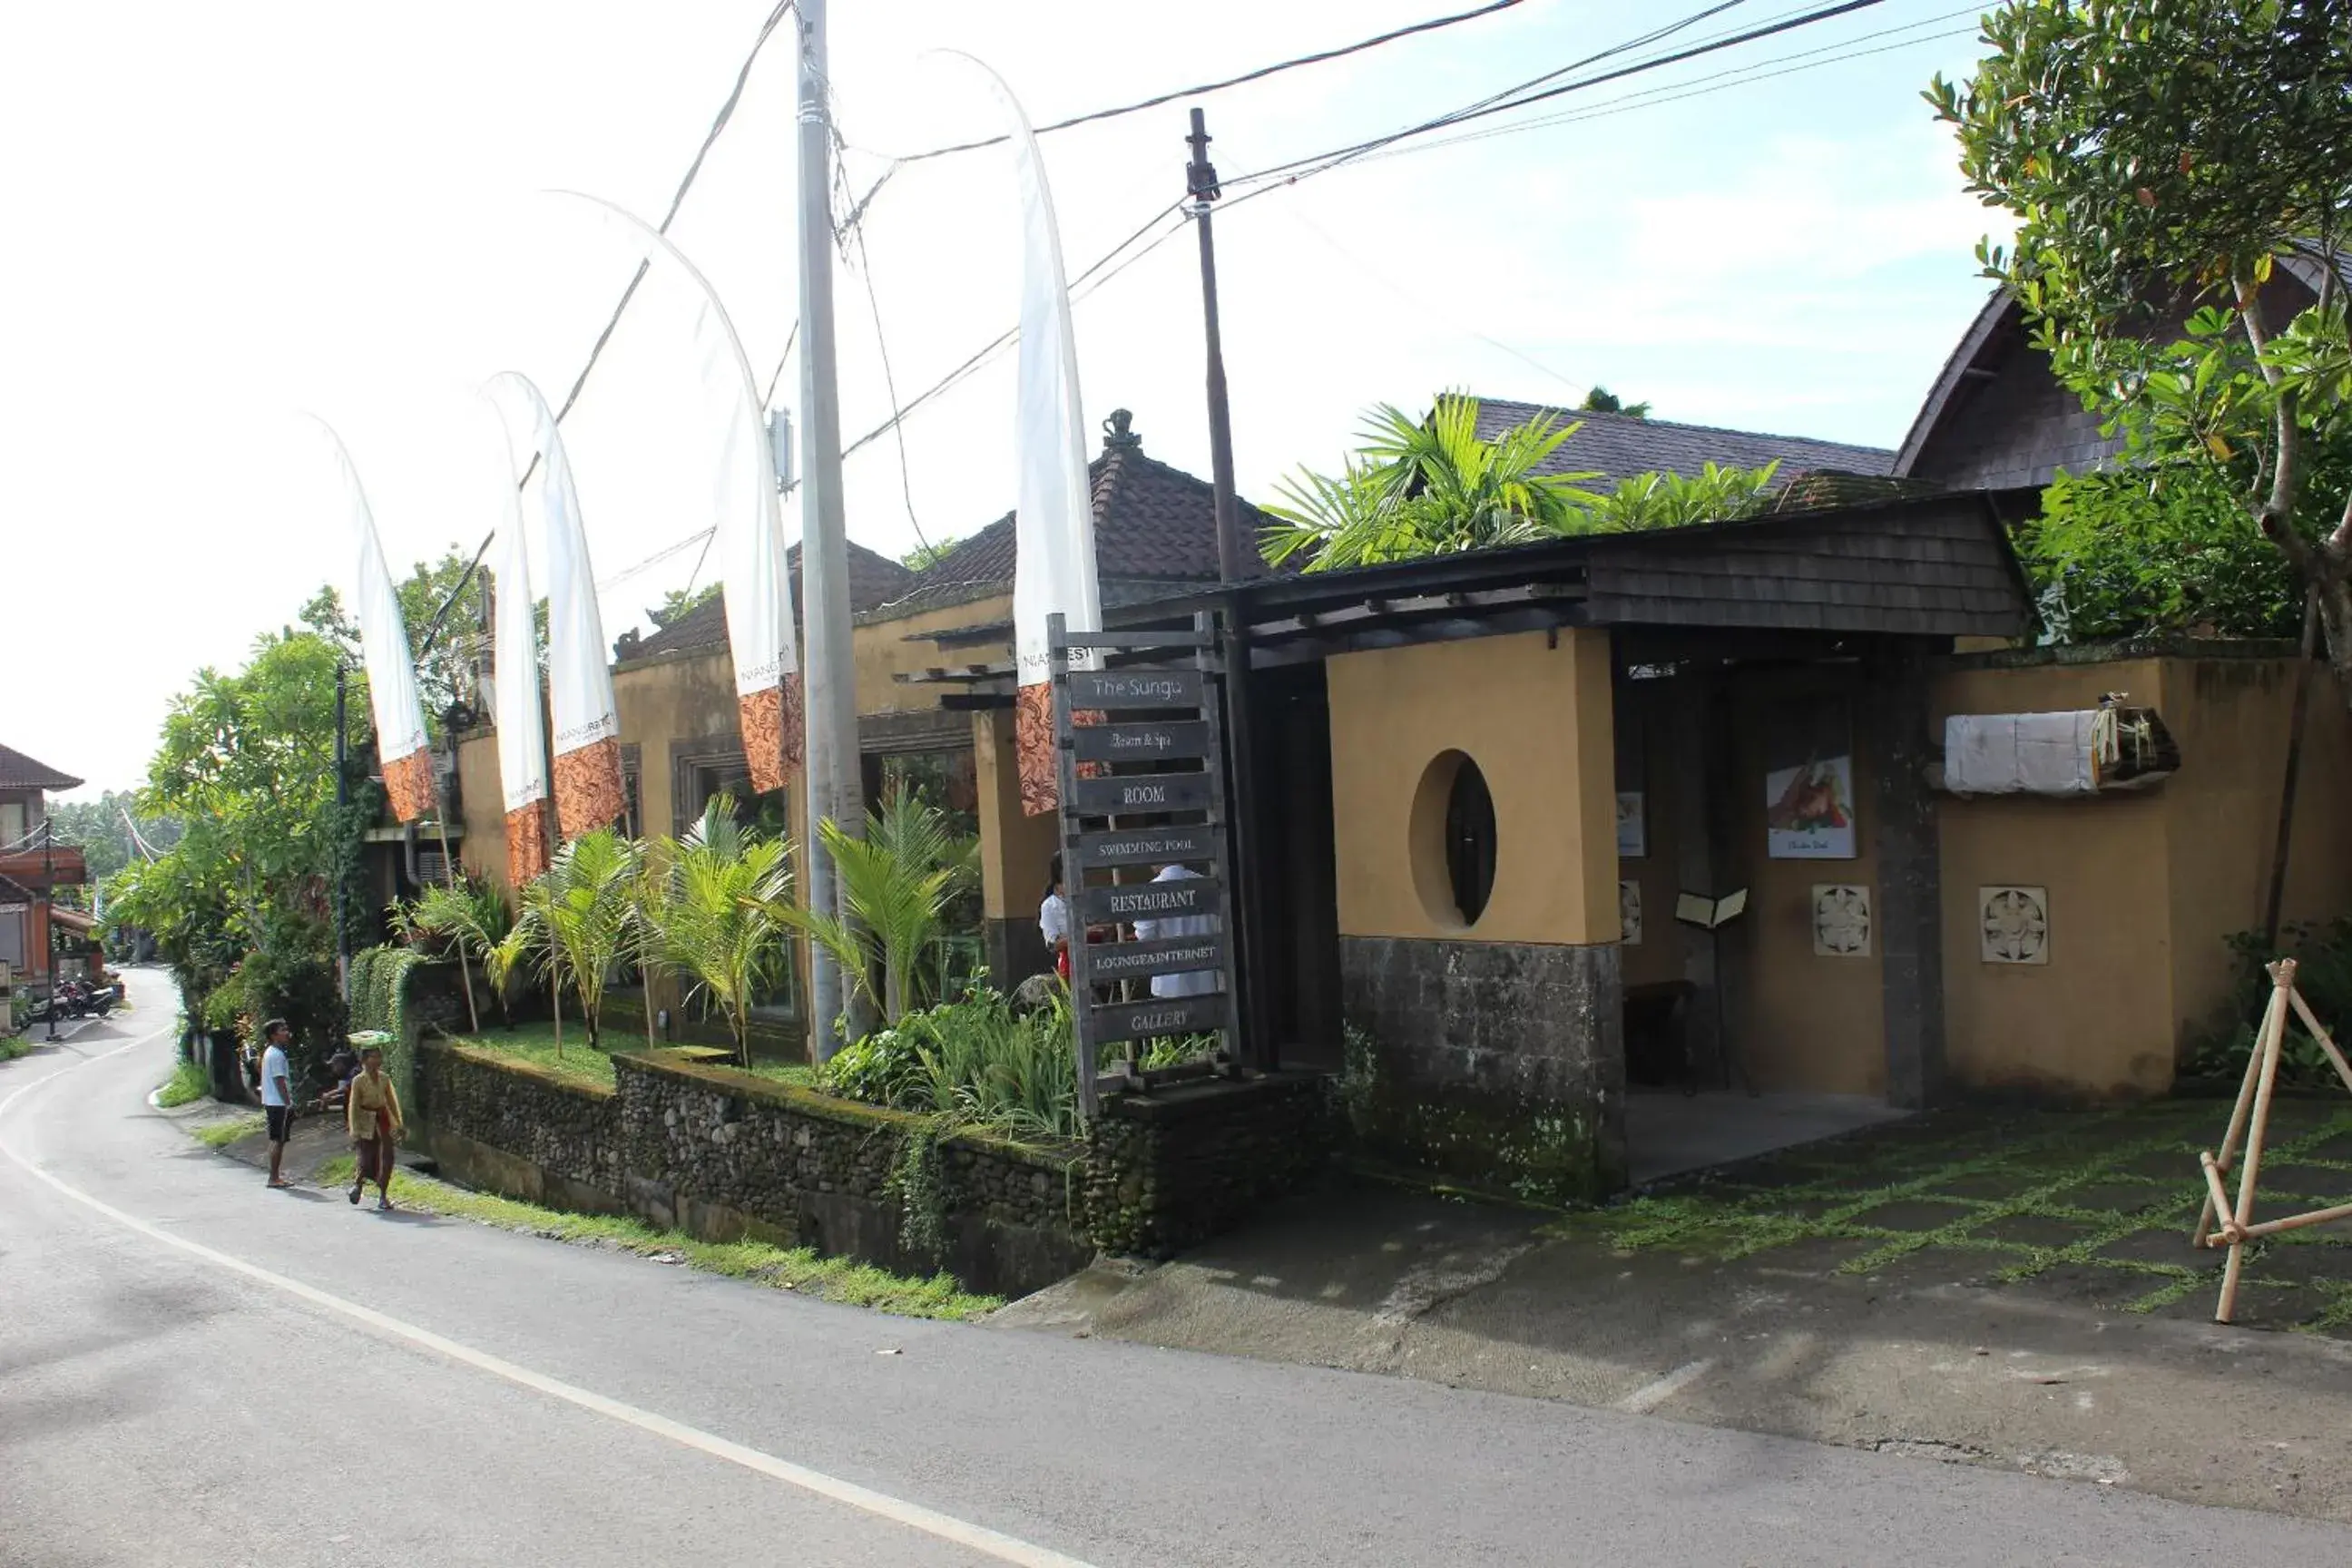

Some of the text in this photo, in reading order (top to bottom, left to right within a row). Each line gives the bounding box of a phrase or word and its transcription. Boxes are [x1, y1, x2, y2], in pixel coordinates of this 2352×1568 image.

[1092, 678, 1182, 701] The Sungu
[1123, 785, 1165, 805] ROOM
[1098, 838, 1197, 856] SWIMMING POOL
[1110, 889, 1197, 914] RESTAURANT
[1131, 1008, 1189, 1031] GALLERY
